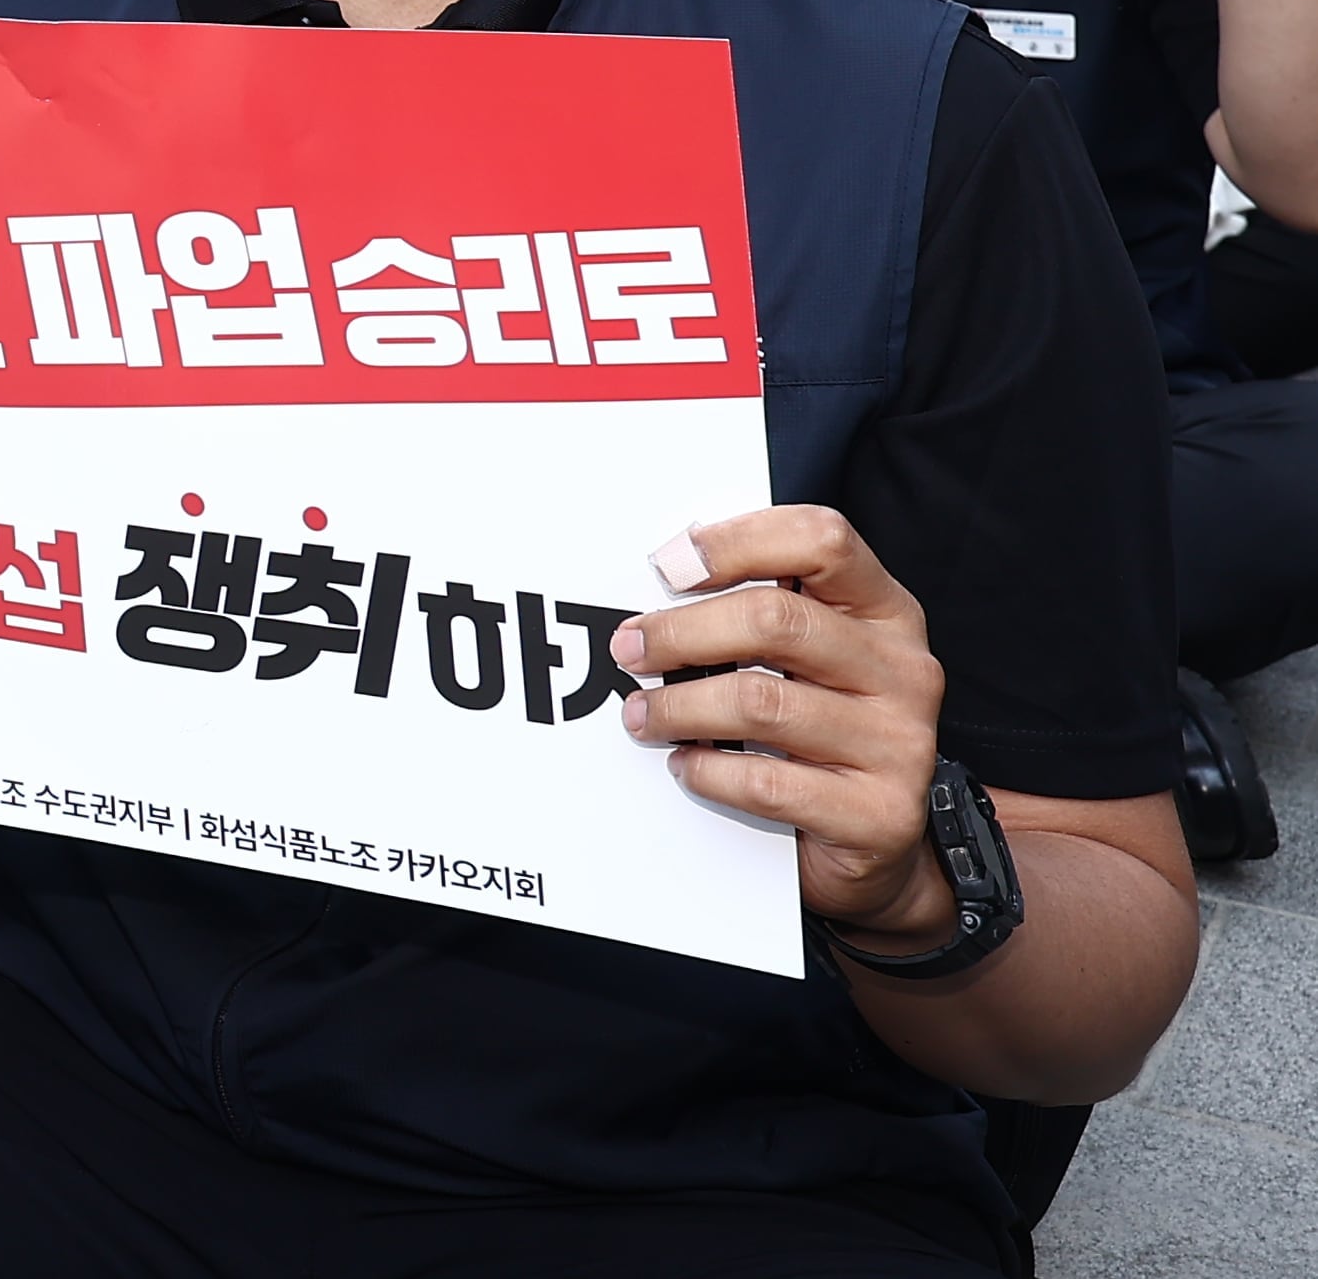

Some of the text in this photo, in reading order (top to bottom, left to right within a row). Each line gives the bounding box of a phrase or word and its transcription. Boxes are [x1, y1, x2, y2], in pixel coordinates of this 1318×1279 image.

[6, 205, 325, 369] 파업
[330, 225, 730, 367] 승리로
[114, 520, 412, 698] 쟁취
[33, 780, 176, 838] 수도권지부
[198, 810, 381, 875] 화섬식품노조
[386, 843, 547, 908] 카카오지회
